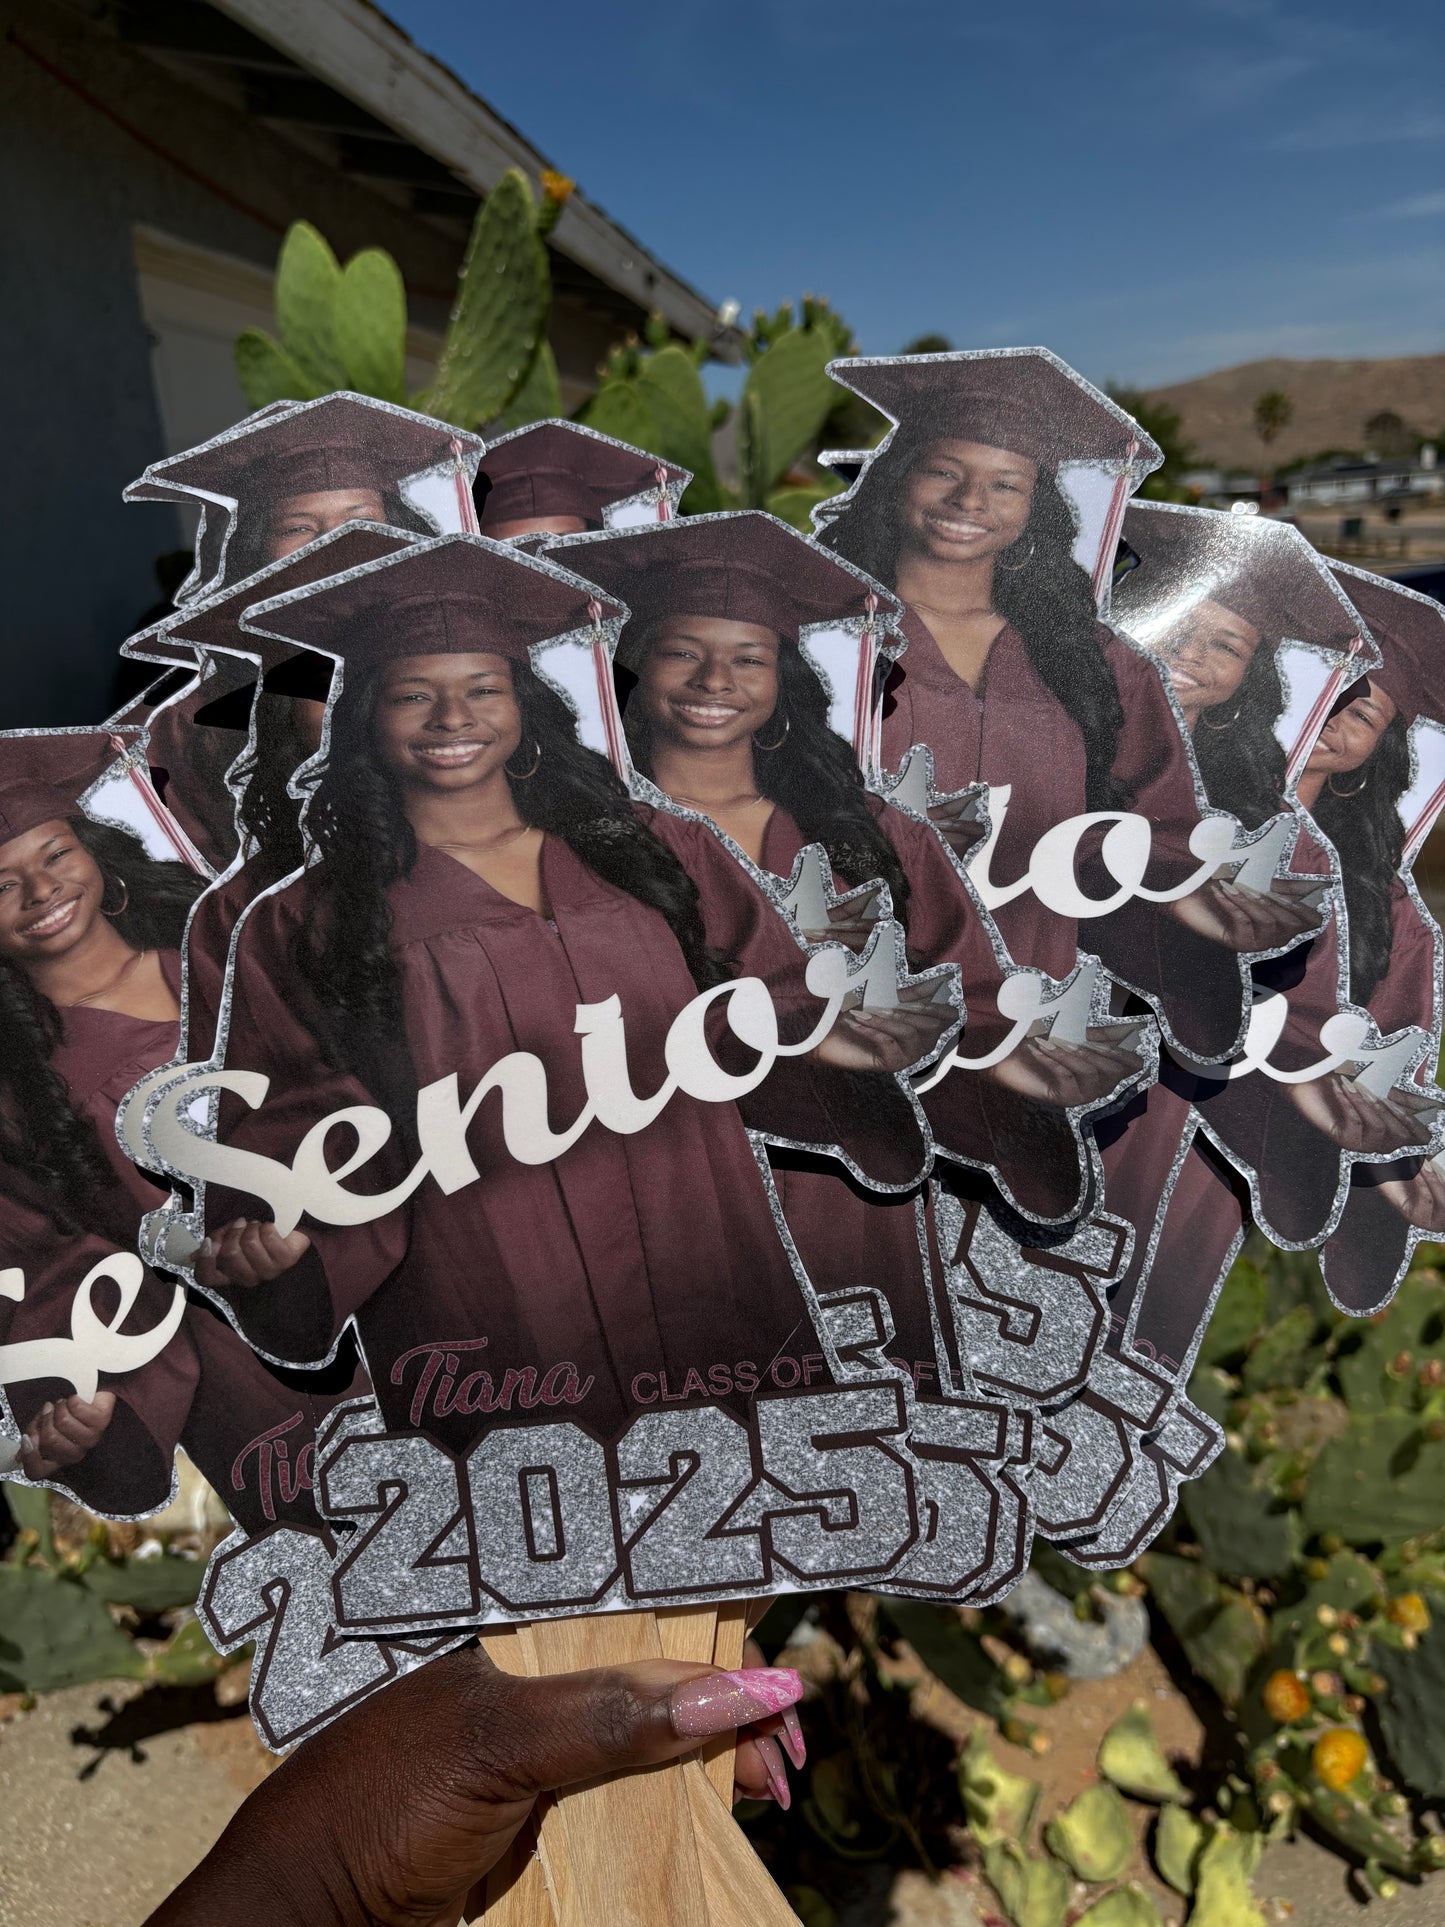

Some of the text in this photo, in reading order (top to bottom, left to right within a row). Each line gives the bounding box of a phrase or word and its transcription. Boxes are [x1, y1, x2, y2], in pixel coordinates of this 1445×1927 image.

[151, 923, 898, 1266] Senior
[391, 1336, 595, 1428] Tiana
[631, 1353, 823, 1405] CLASS OF
[319, 1380, 922, 1627] 2025
